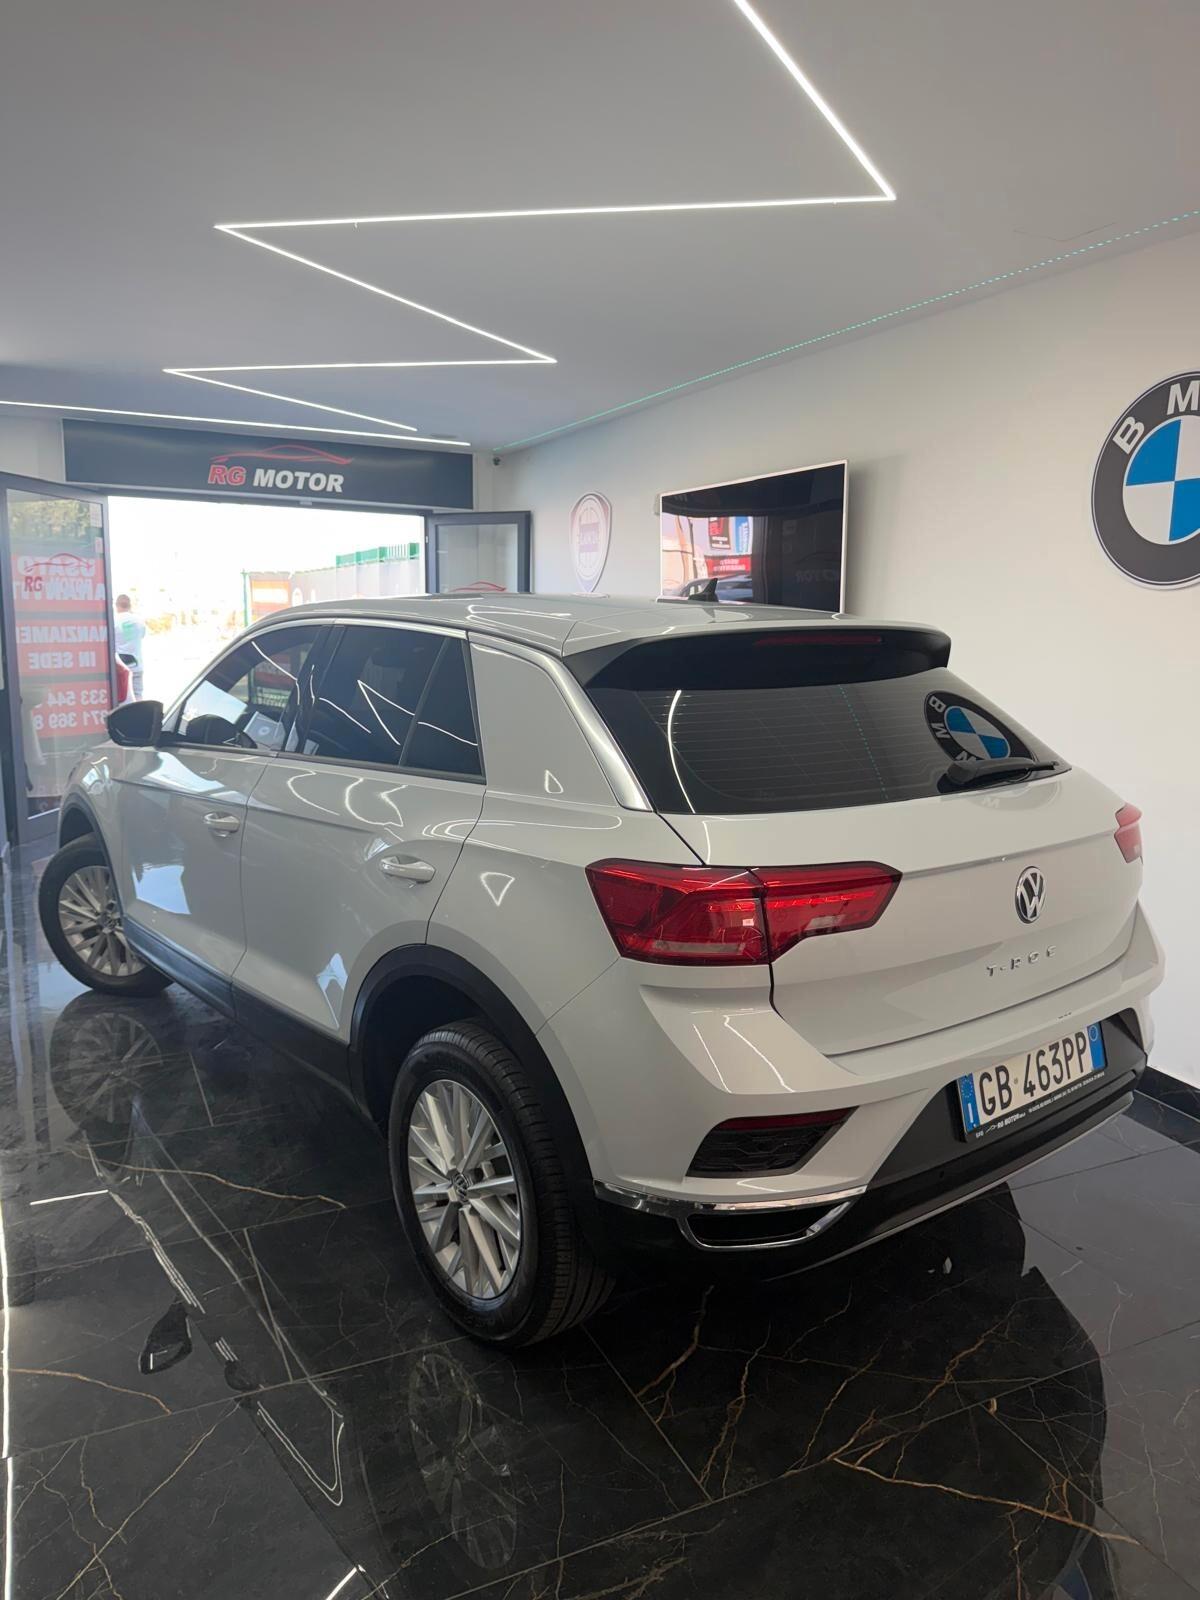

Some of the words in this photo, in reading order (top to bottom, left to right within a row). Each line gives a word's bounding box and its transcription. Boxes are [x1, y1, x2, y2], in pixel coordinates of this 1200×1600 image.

[208, 465, 246, 486] RG
[253, 468, 344, 493] MOTOR
[24, 576, 42, 592] RG
